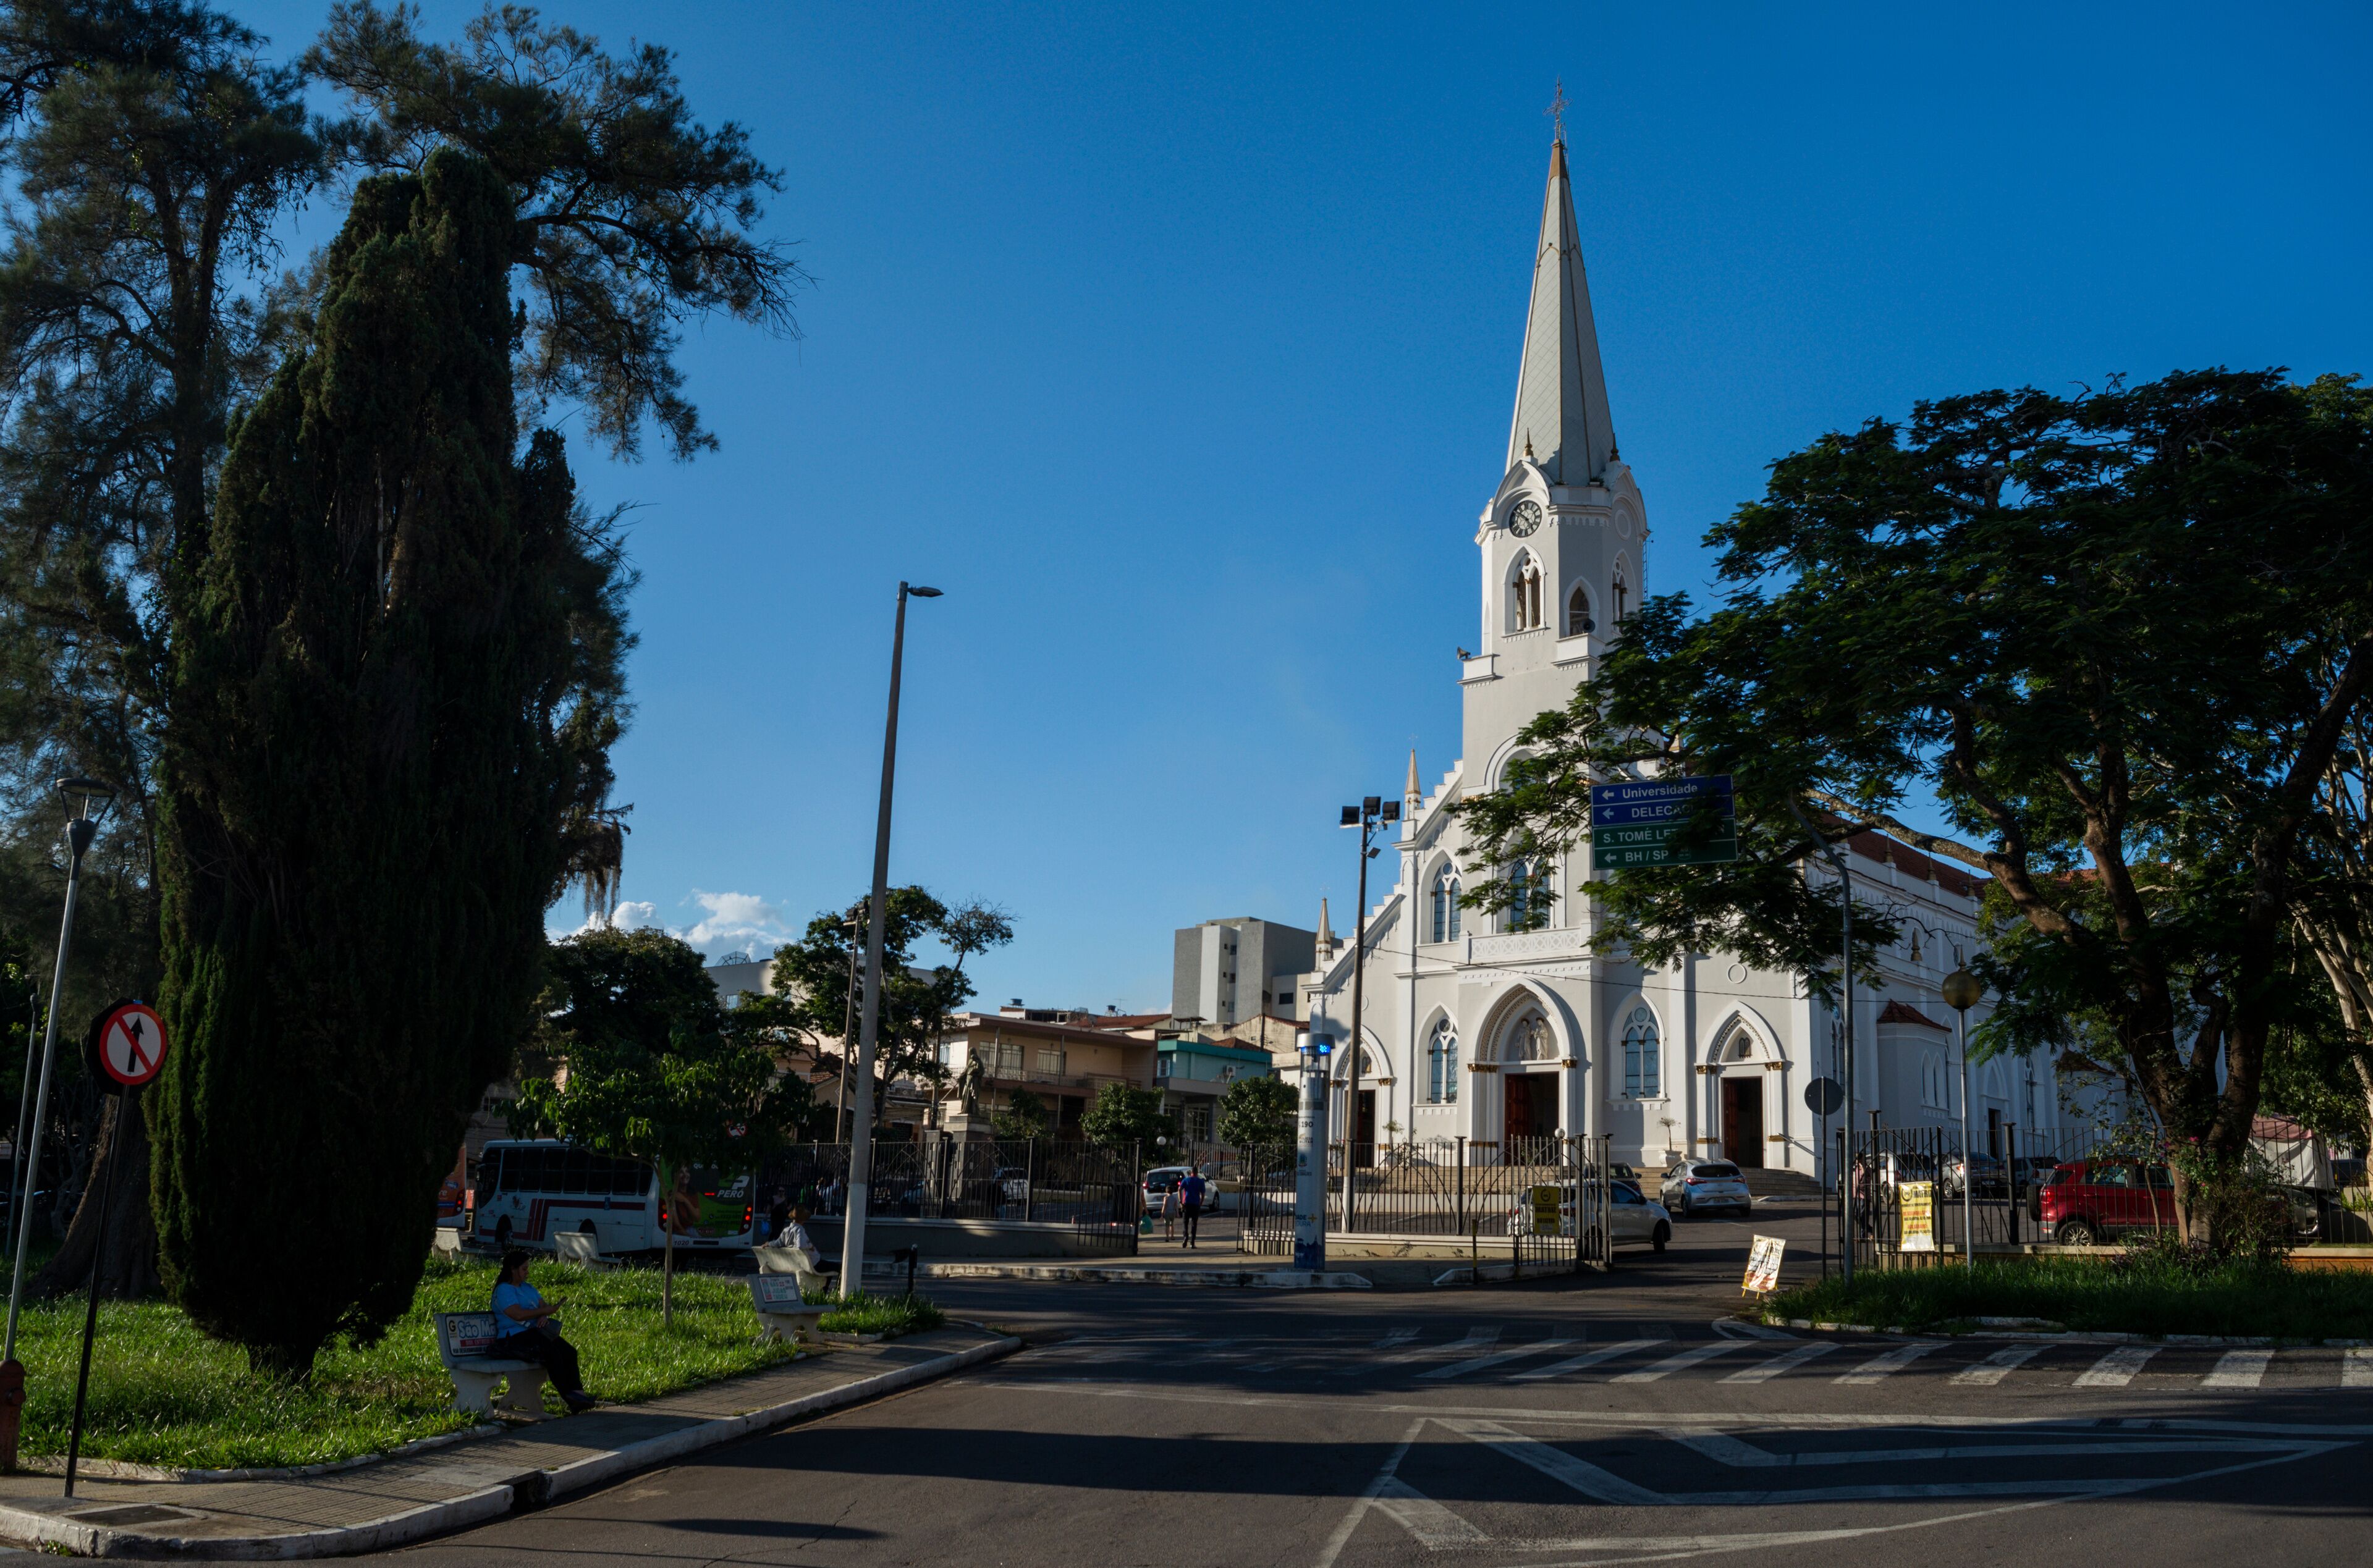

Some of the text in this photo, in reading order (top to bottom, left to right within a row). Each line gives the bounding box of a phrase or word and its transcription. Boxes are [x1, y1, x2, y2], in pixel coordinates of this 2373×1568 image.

[1622, 783, 1698, 799] Universidade
[1603, 833, 1614, 843] S.
[1618, 828, 1652, 842] TOMÉ
[1625, 852, 1642, 862] BH
[1646, 851, 1649, 861] /
[1652, 850, 1669, 861] SP
[717, 1188, 745, 1199] PERÓ
[457, 1320, 479, 1339] São
